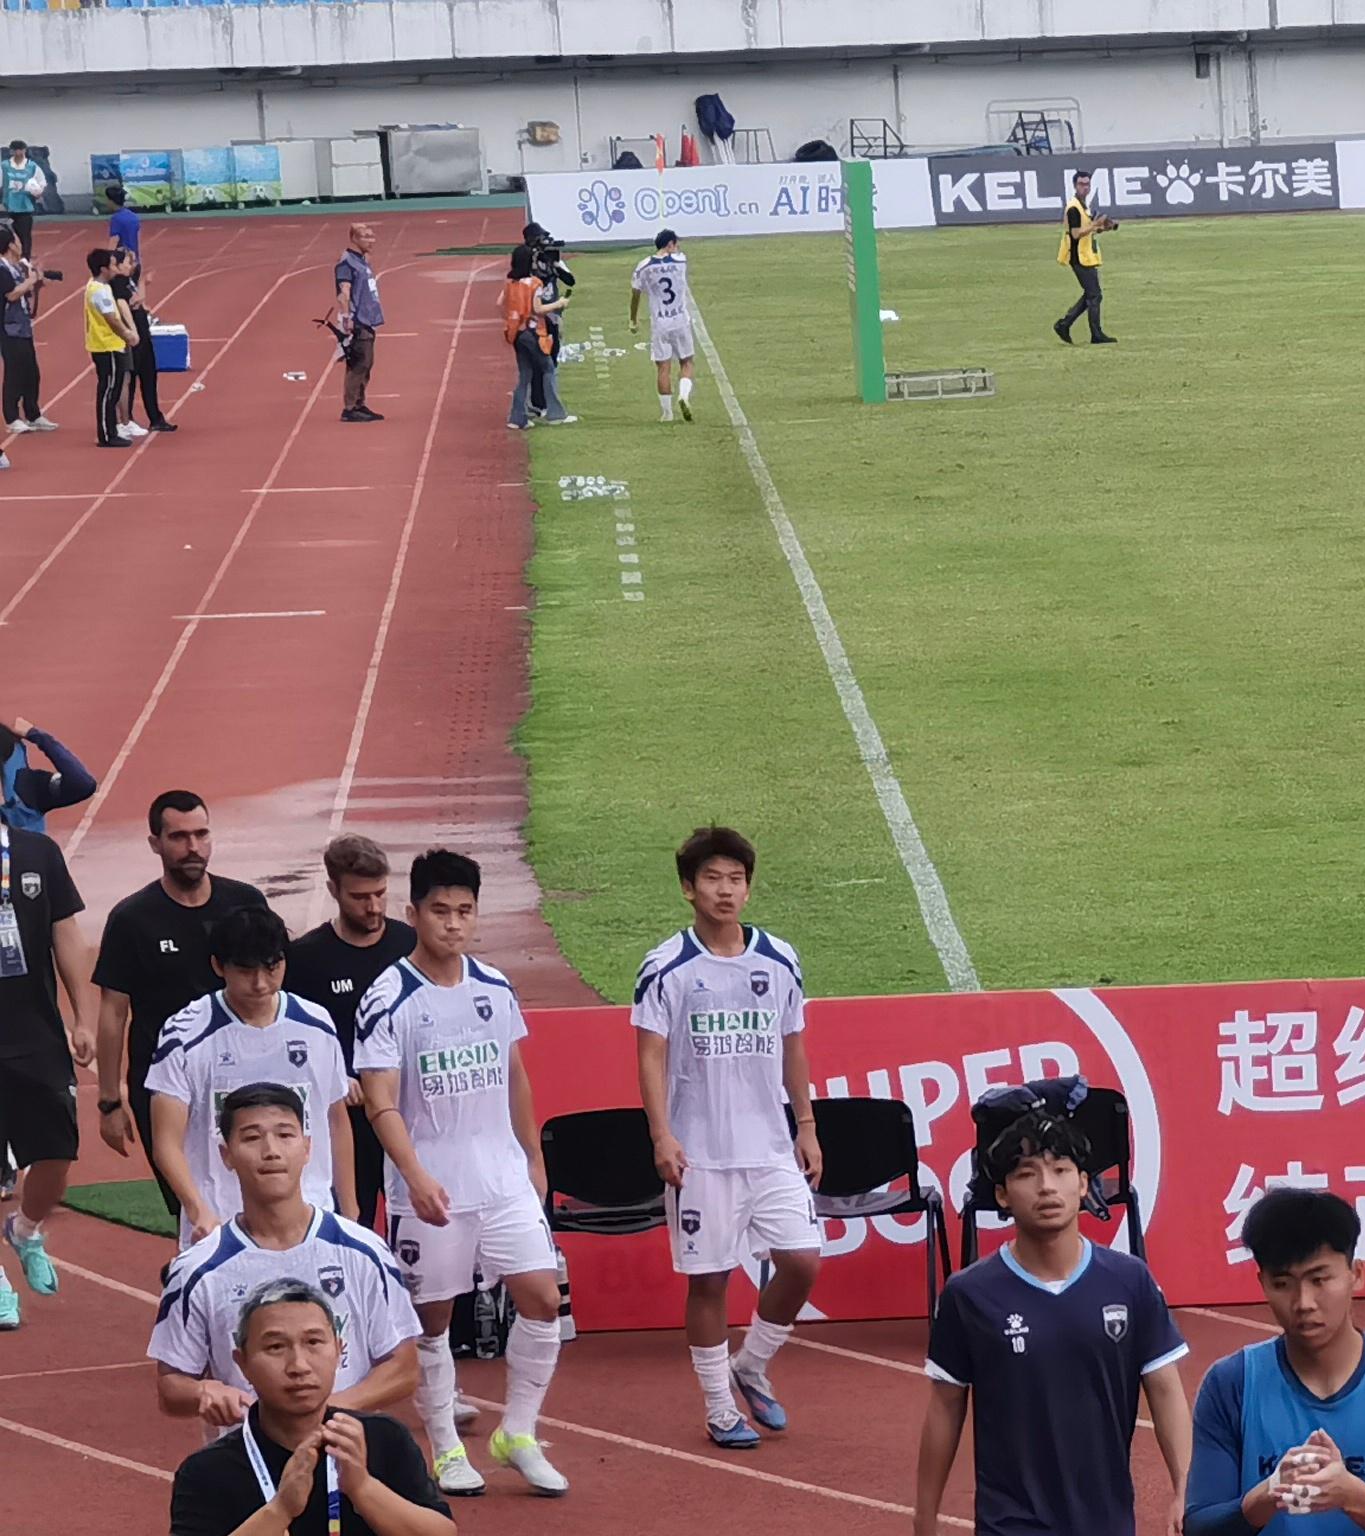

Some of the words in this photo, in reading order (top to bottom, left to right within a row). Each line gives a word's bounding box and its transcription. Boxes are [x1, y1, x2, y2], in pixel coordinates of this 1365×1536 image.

[939, 166, 1151, 213] KELME
[1205, 157, 1333, 200] 卡尔美
[657, 276, 677, 305] 3
[160, 939, 180, 953] FL
[331, 977, 354, 993] UM
